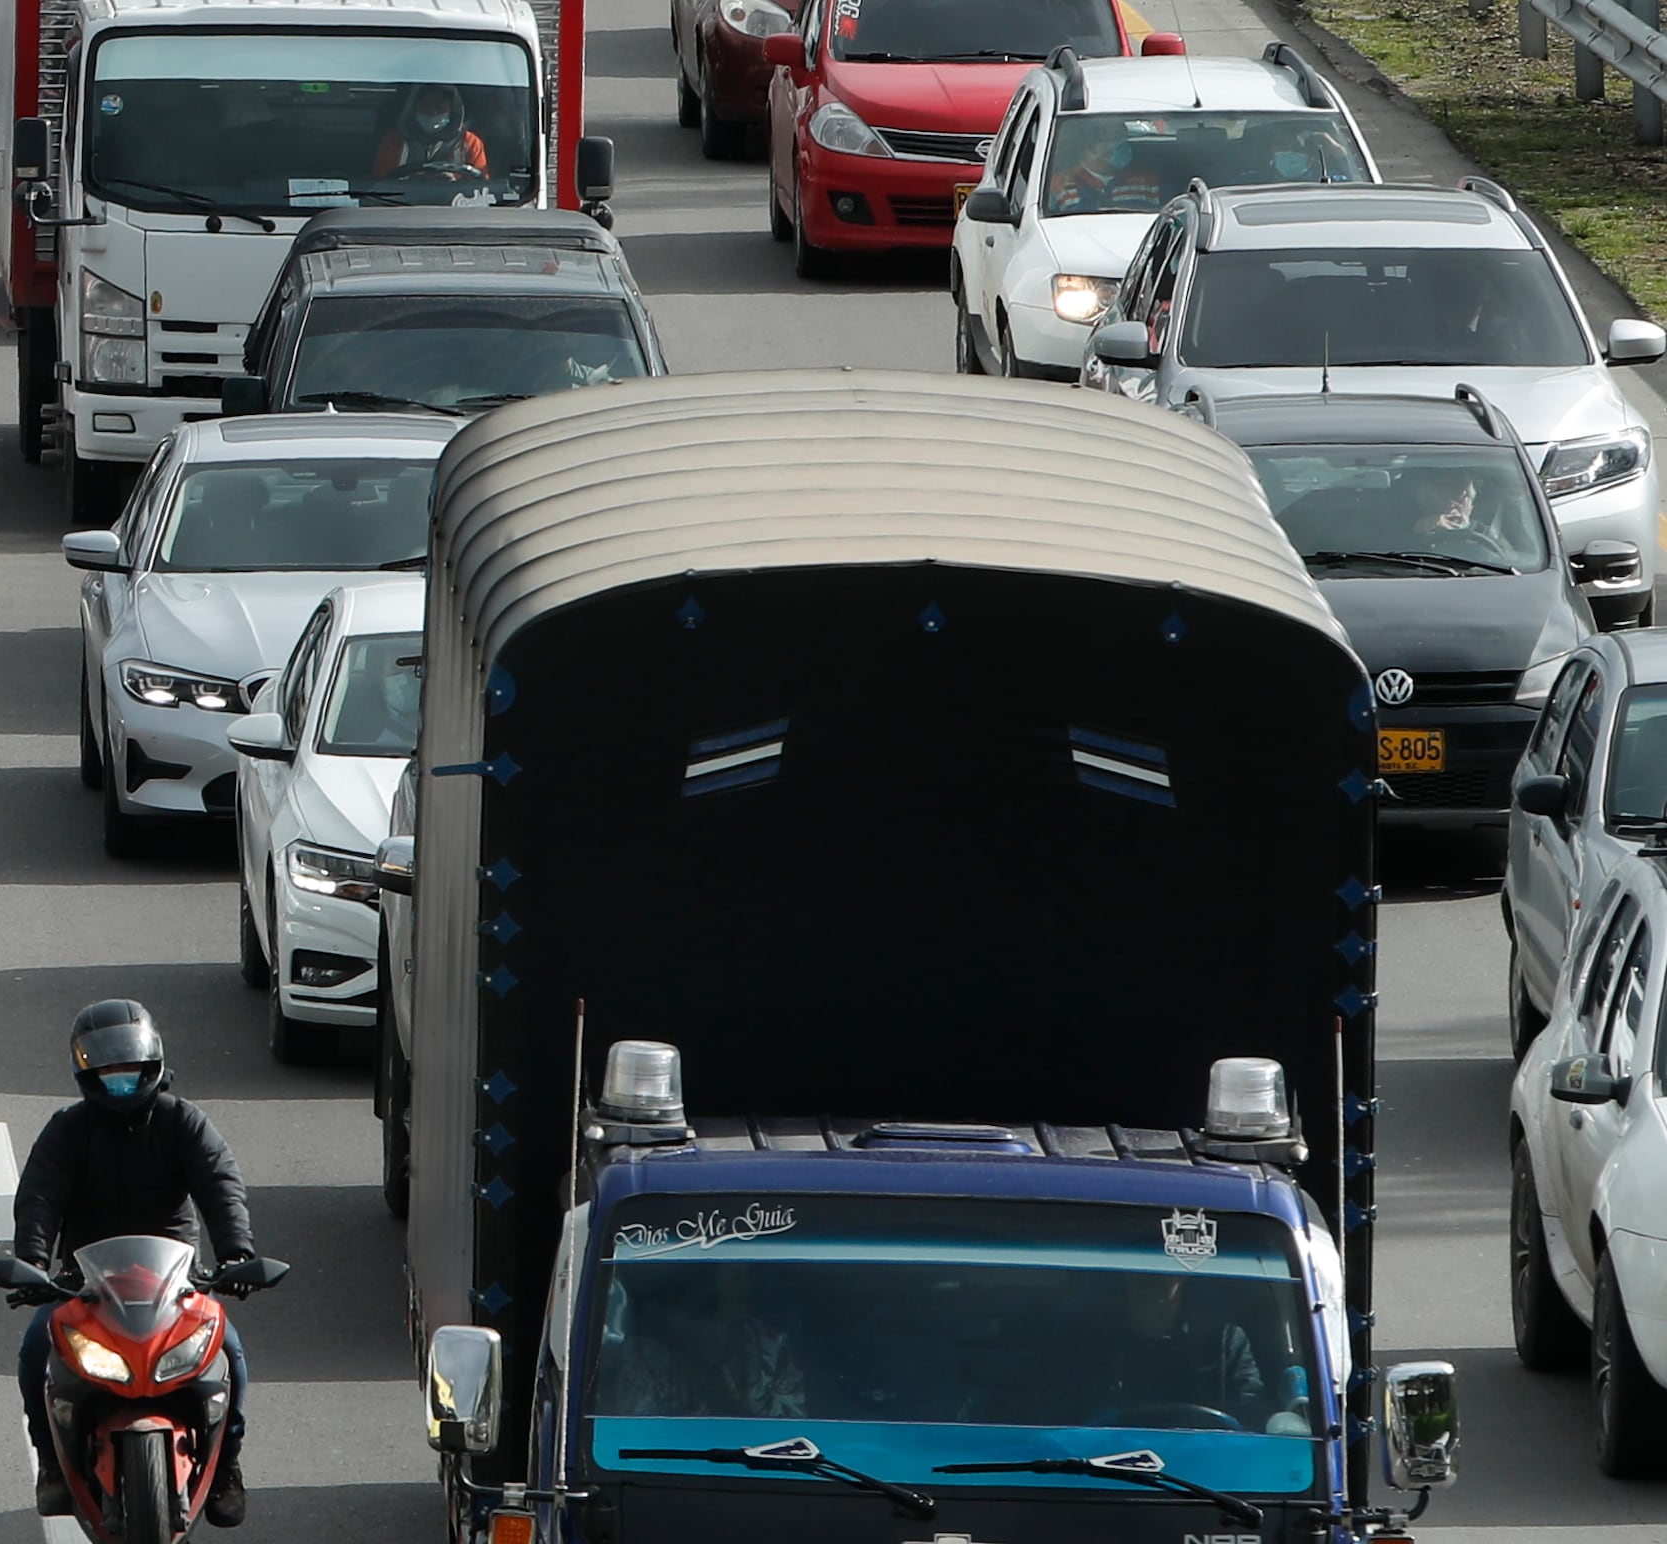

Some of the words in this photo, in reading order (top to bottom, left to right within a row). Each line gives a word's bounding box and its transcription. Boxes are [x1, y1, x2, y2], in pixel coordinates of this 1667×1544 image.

[614, 1223, 669, 1249] Dios
[676, 1209, 726, 1241] Me
[732, 1202, 795, 1241] Guia
[1164, 1245, 1212, 1256] TRUCK
